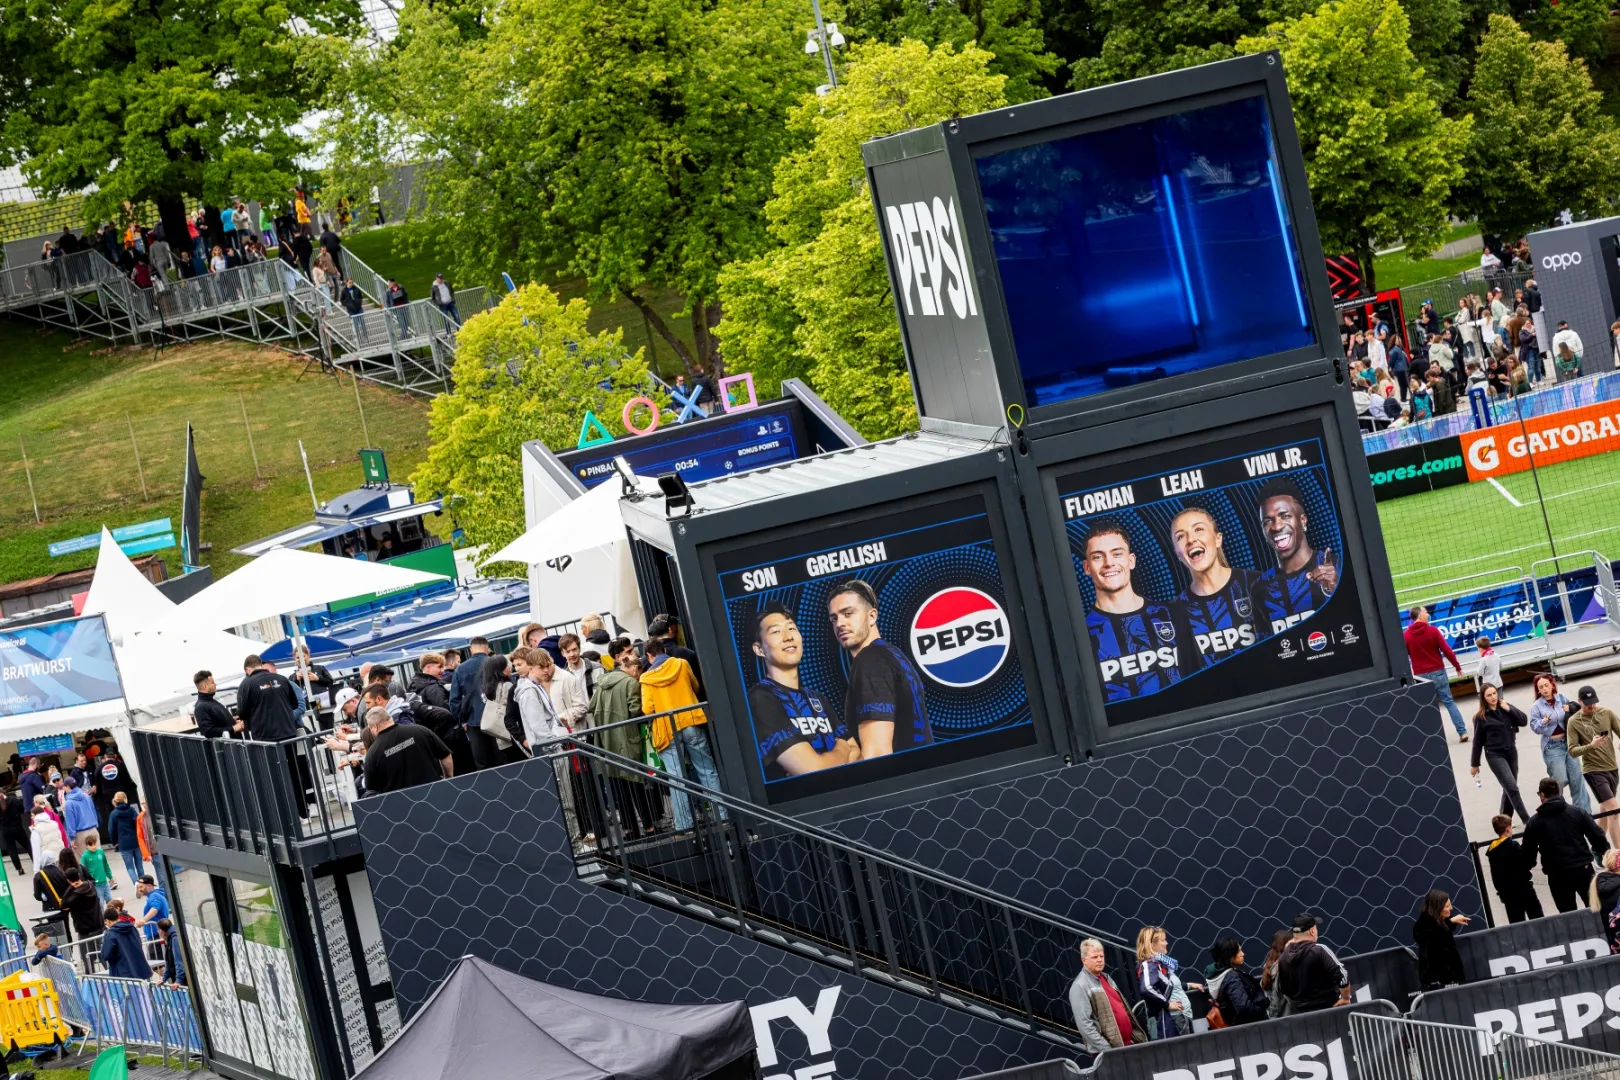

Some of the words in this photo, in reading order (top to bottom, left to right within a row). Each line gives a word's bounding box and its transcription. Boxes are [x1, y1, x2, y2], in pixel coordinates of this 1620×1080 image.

[886, 196, 978, 320] PEPSI
[1542, 251, 1582, 272] oppo
[737, 446, 758, 457] BONUS
[758, 440, 780, 451] POINTS
[1507, 412, 1620, 459] GATORA
[586, 461, 617, 476] PINBAL
[674, 458, 700, 472] 00:54
[1243, 452, 1279, 477] VINI
[1281, 446, 1308, 470] JR.
[1370, 453, 1462, 487] ores.com
[1160, 469, 1205, 497] LEAH
[1064, 485, 1135, 519] FLORIAN
[806, 541, 887, 577] GREALISH
[741, 566, 778, 592] SON
[916, 617, 1005, 656] PEPSI
[3, 657, 73, 681] BRATWURST
